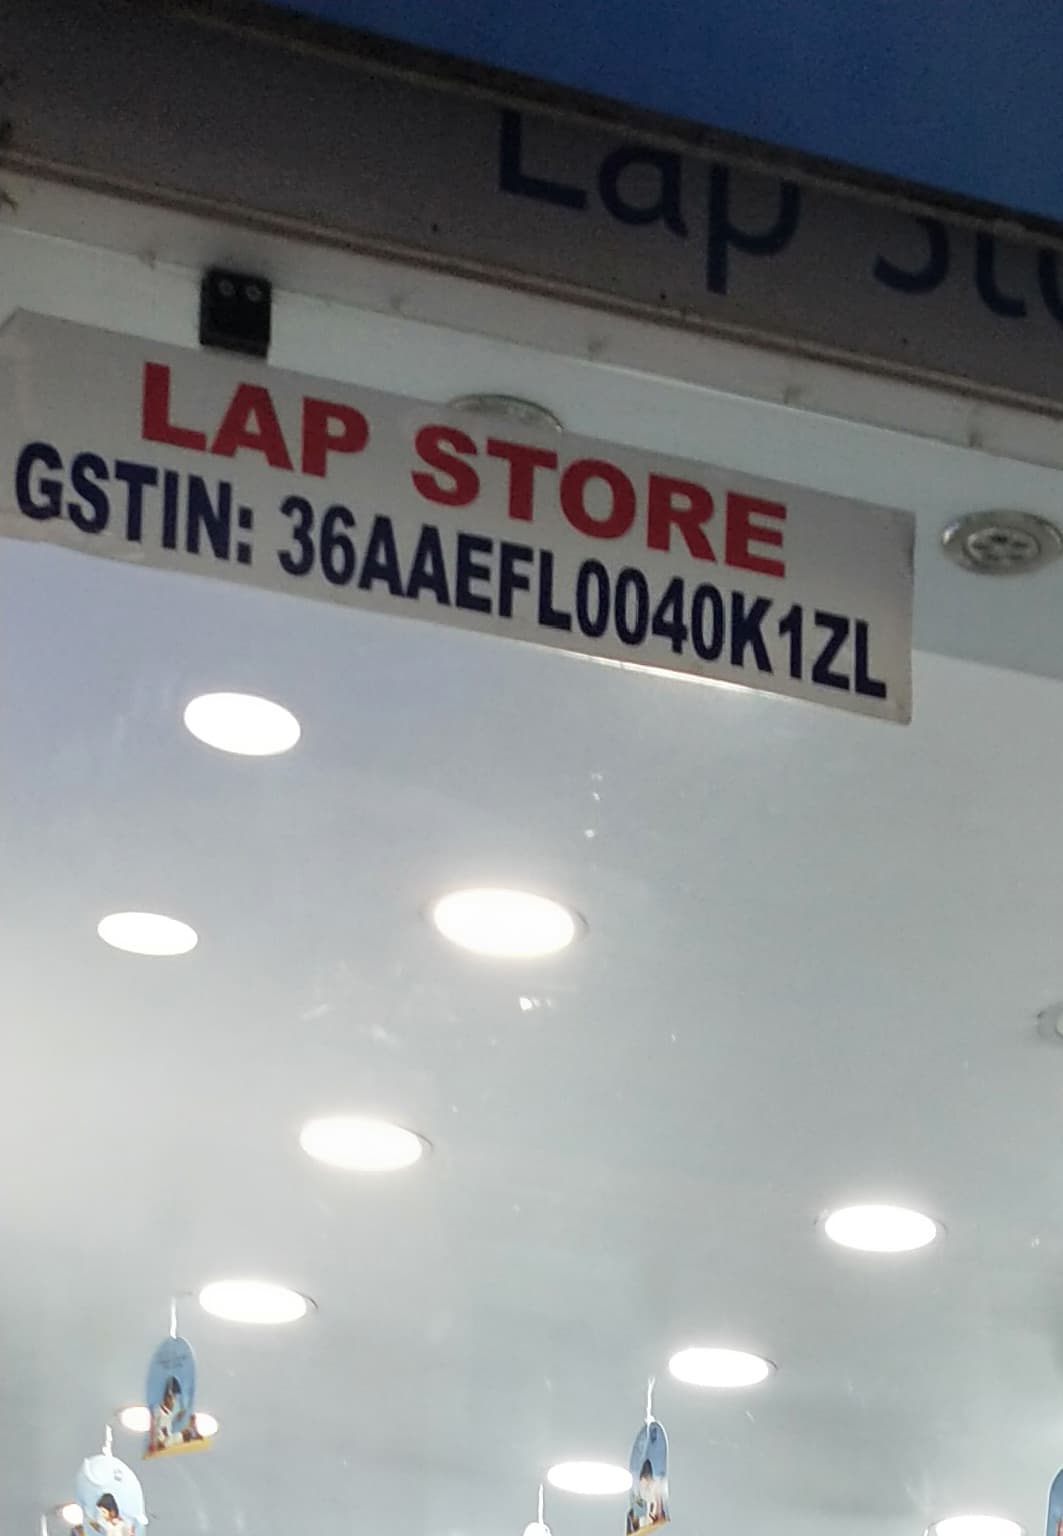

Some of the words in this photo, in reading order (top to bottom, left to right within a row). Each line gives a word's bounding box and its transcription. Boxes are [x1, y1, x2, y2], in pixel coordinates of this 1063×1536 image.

[15, 440, 253, 565] GSTIN:
[279, 495, 887, 699] 36AAEFL0040K1ZL
[141, 361, 370, 478] LAP
[411, 422, 788, 578] STORE
